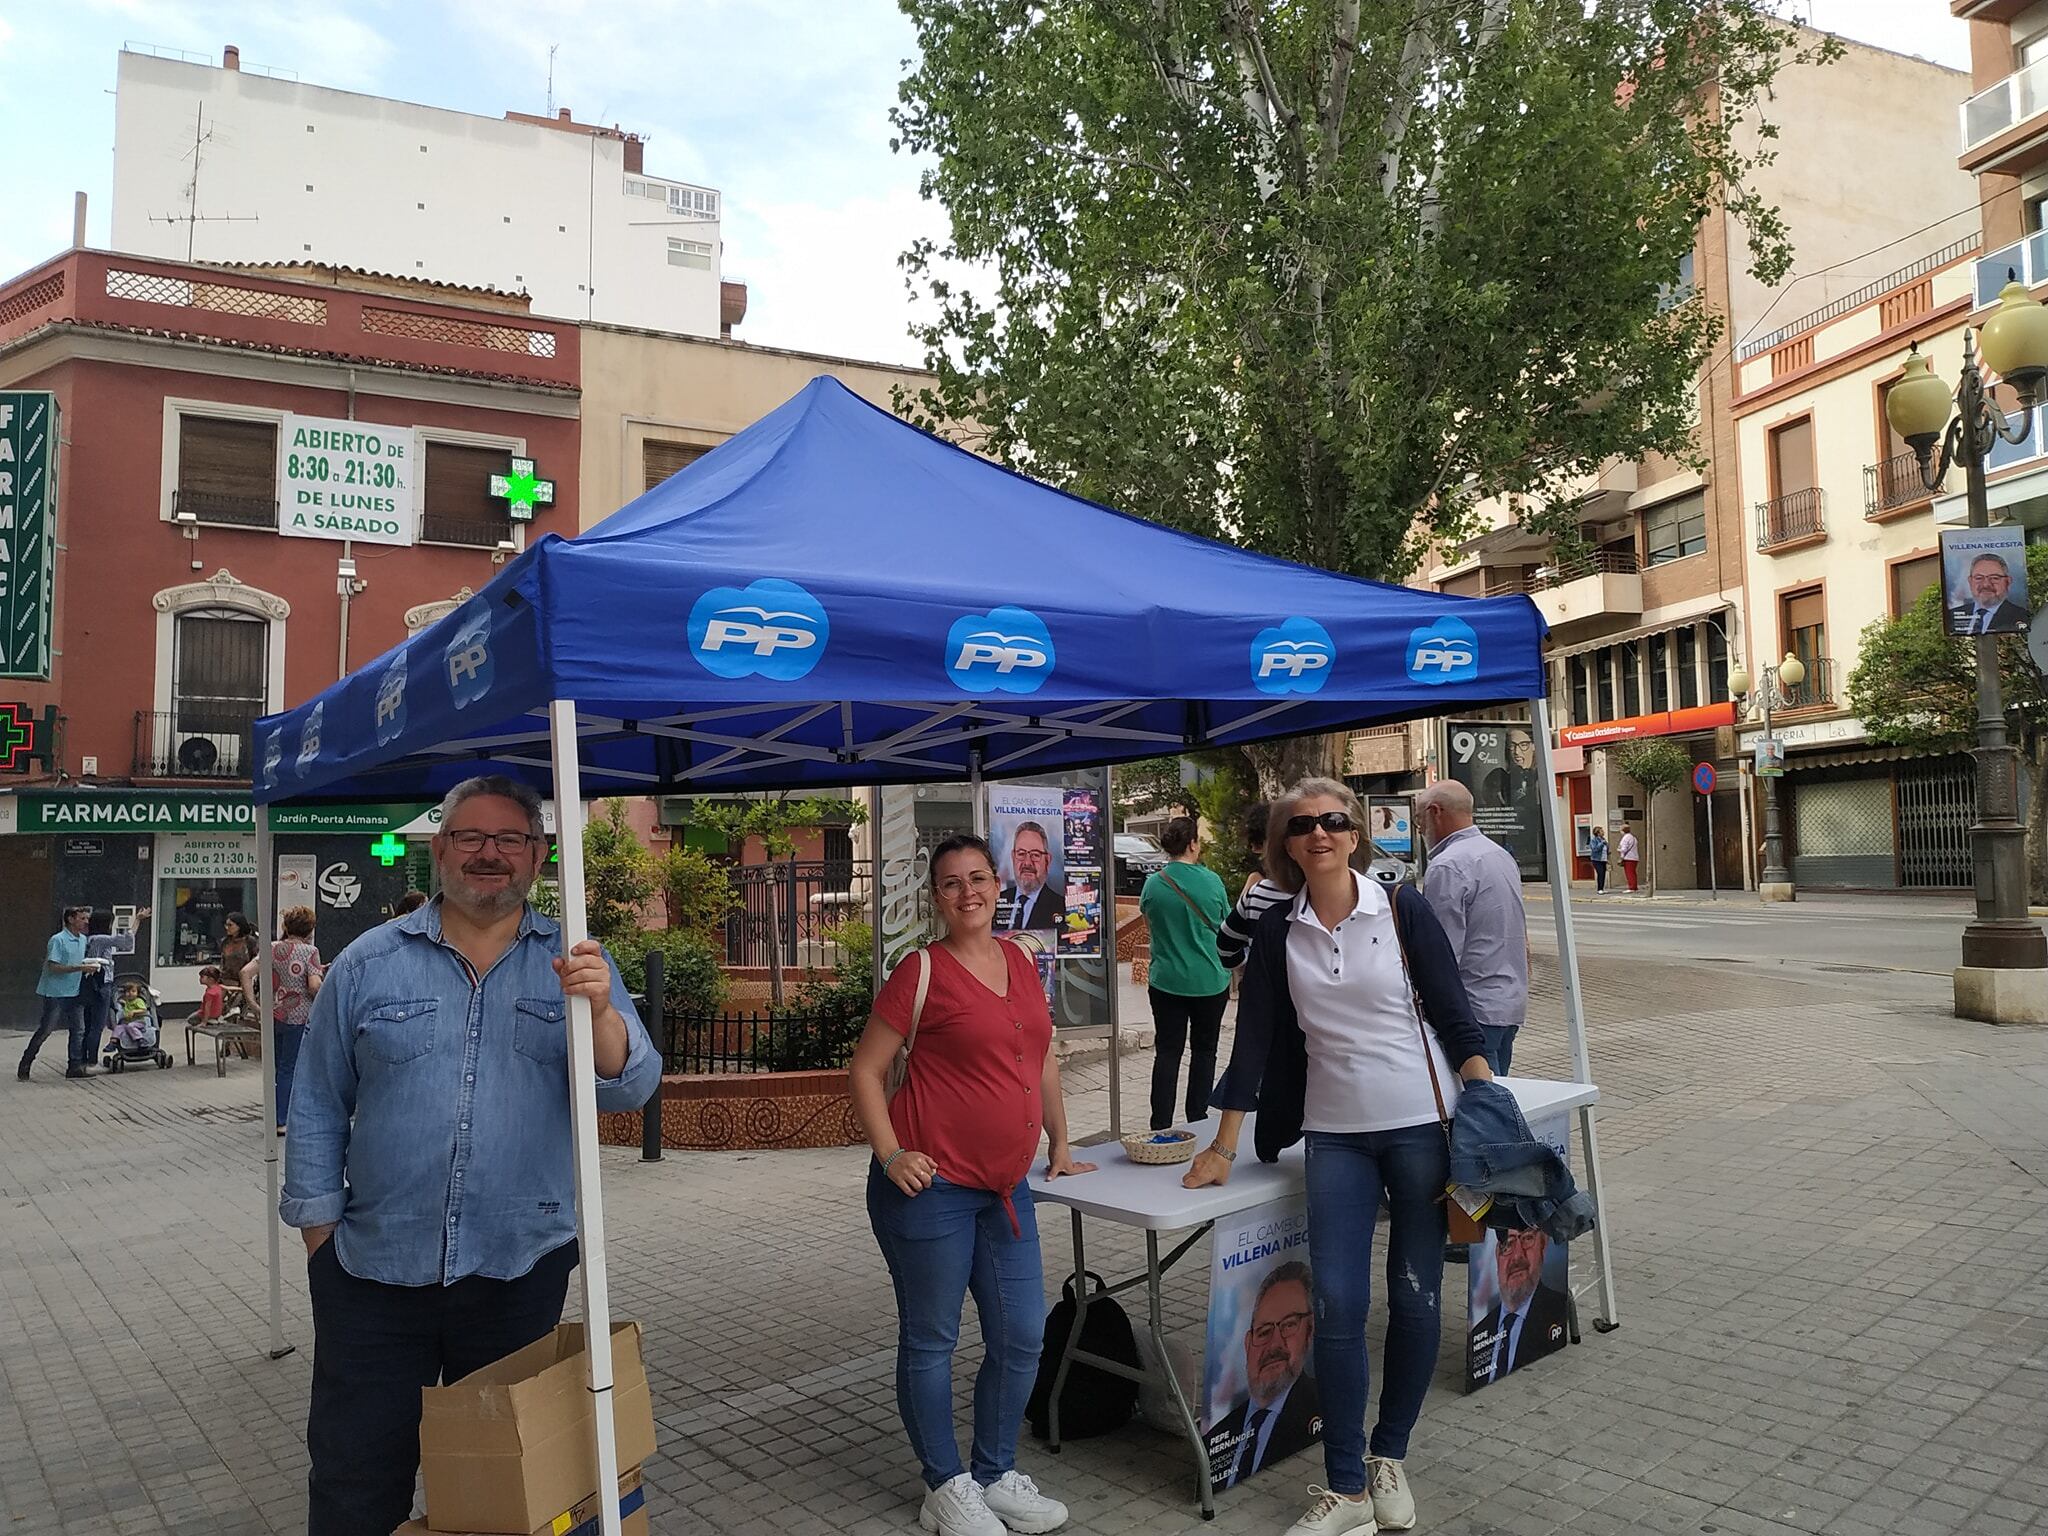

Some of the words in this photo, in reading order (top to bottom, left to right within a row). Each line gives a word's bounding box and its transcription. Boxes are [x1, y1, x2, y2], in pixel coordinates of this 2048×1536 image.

[293, 428, 382, 456] ABIERTO
[387, 444, 404, 459] DE
[287, 453, 330, 482] 8:30
[332, 473, 340, 482] a
[344, 459, 396, 489] 21:30
[297, 490, 323, 506] DE
[330, 493, 396, 513] LUNES
[292, 513, 307, 528] A
[314, 510, 400, 535] SÁBADO
[1948, 543, 1983, 551] VILLENA
[1983, 541, 2023, 550] NECESITA
[700, 620, 816, 656] PP
[449, 644, 487, 687] PP
[954, 643, 1046, 673] PP
[1258, 653, 1329, 677] PP
[1411, 649, 1473, 672] PP
[41, 803, 173, 823] FARMACIA
[179, 803, 257, 823] MENO
[276, 813, 308, 825] Jardín
[310, 814, 344, 825] Puerta
[345, 814, 389, 825] Almansa
[994, 806, 1027, 815] VILLENA
[1027, 807, 1062, 816] NECESITA
[184, 841, 225, 849] ABIERTO
[228, 841, 241, 849] DE
[163, 867, 177, 875] DE
[179, 866, 211, 875] LUNES
[213, 866, 221, 874] A
[223, 864, 257, 875] SÁBAD
[174, 852, 199, 864] 8:30
[202, 855, 209, 864] a
[213, 852, 244, 864] 21:30
[1238, 1230, 1254, 1248] EL
[1256, 1214, 1305, 1241] CAMBIO
[1222, 1240, 1280, 1271] VILLENA
[1472, 1362, 1498, 1380] VILLENA
[1208, 1427, 1256, 1457] HERNÁNDEZ
[1210, 1430, 1230, 1447] PEPE
